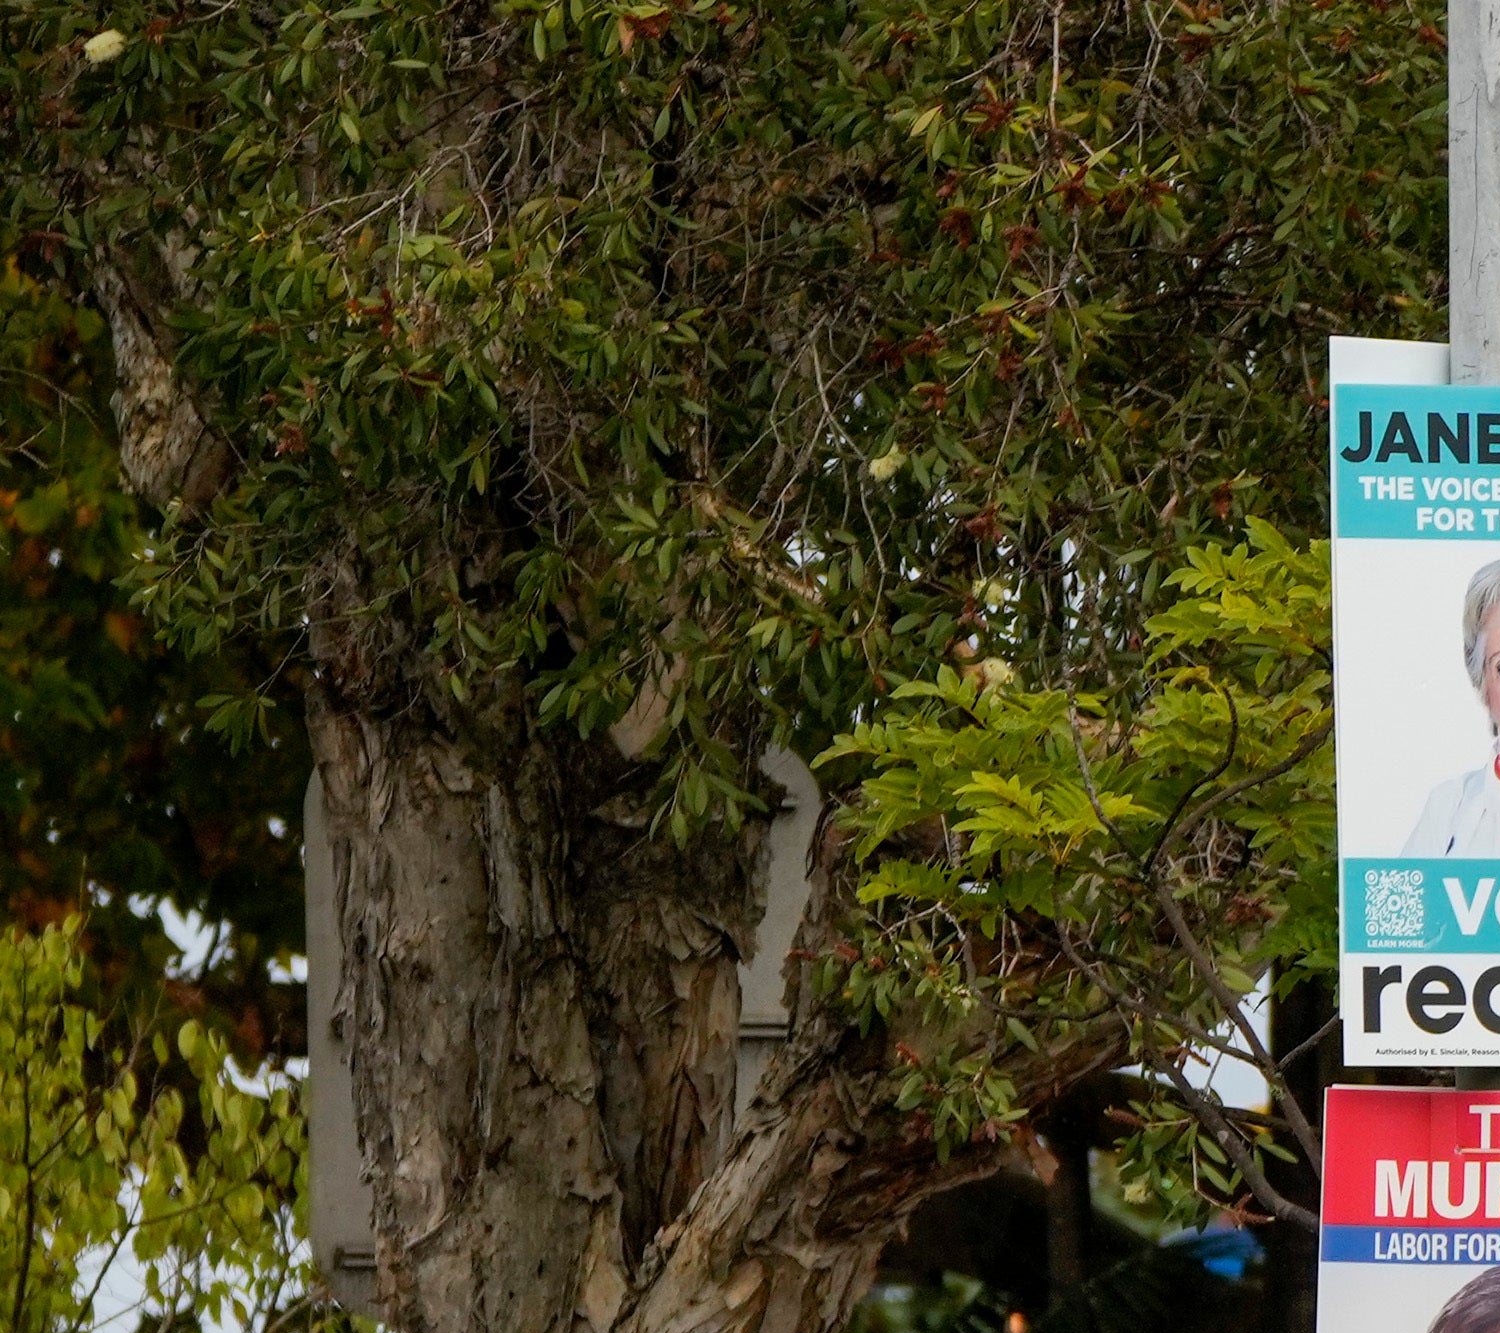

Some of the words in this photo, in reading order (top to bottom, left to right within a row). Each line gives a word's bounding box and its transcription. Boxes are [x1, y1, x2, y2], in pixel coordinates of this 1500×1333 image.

[1358, 476, 1414, 500] THE
[1416, 507, 1474, 531] FOR
[1368, 940, 1396, 948] LEARN
[1399, 940, 1424, 948] MORE
[1374, 1232, 1447, 1261] LABOR
